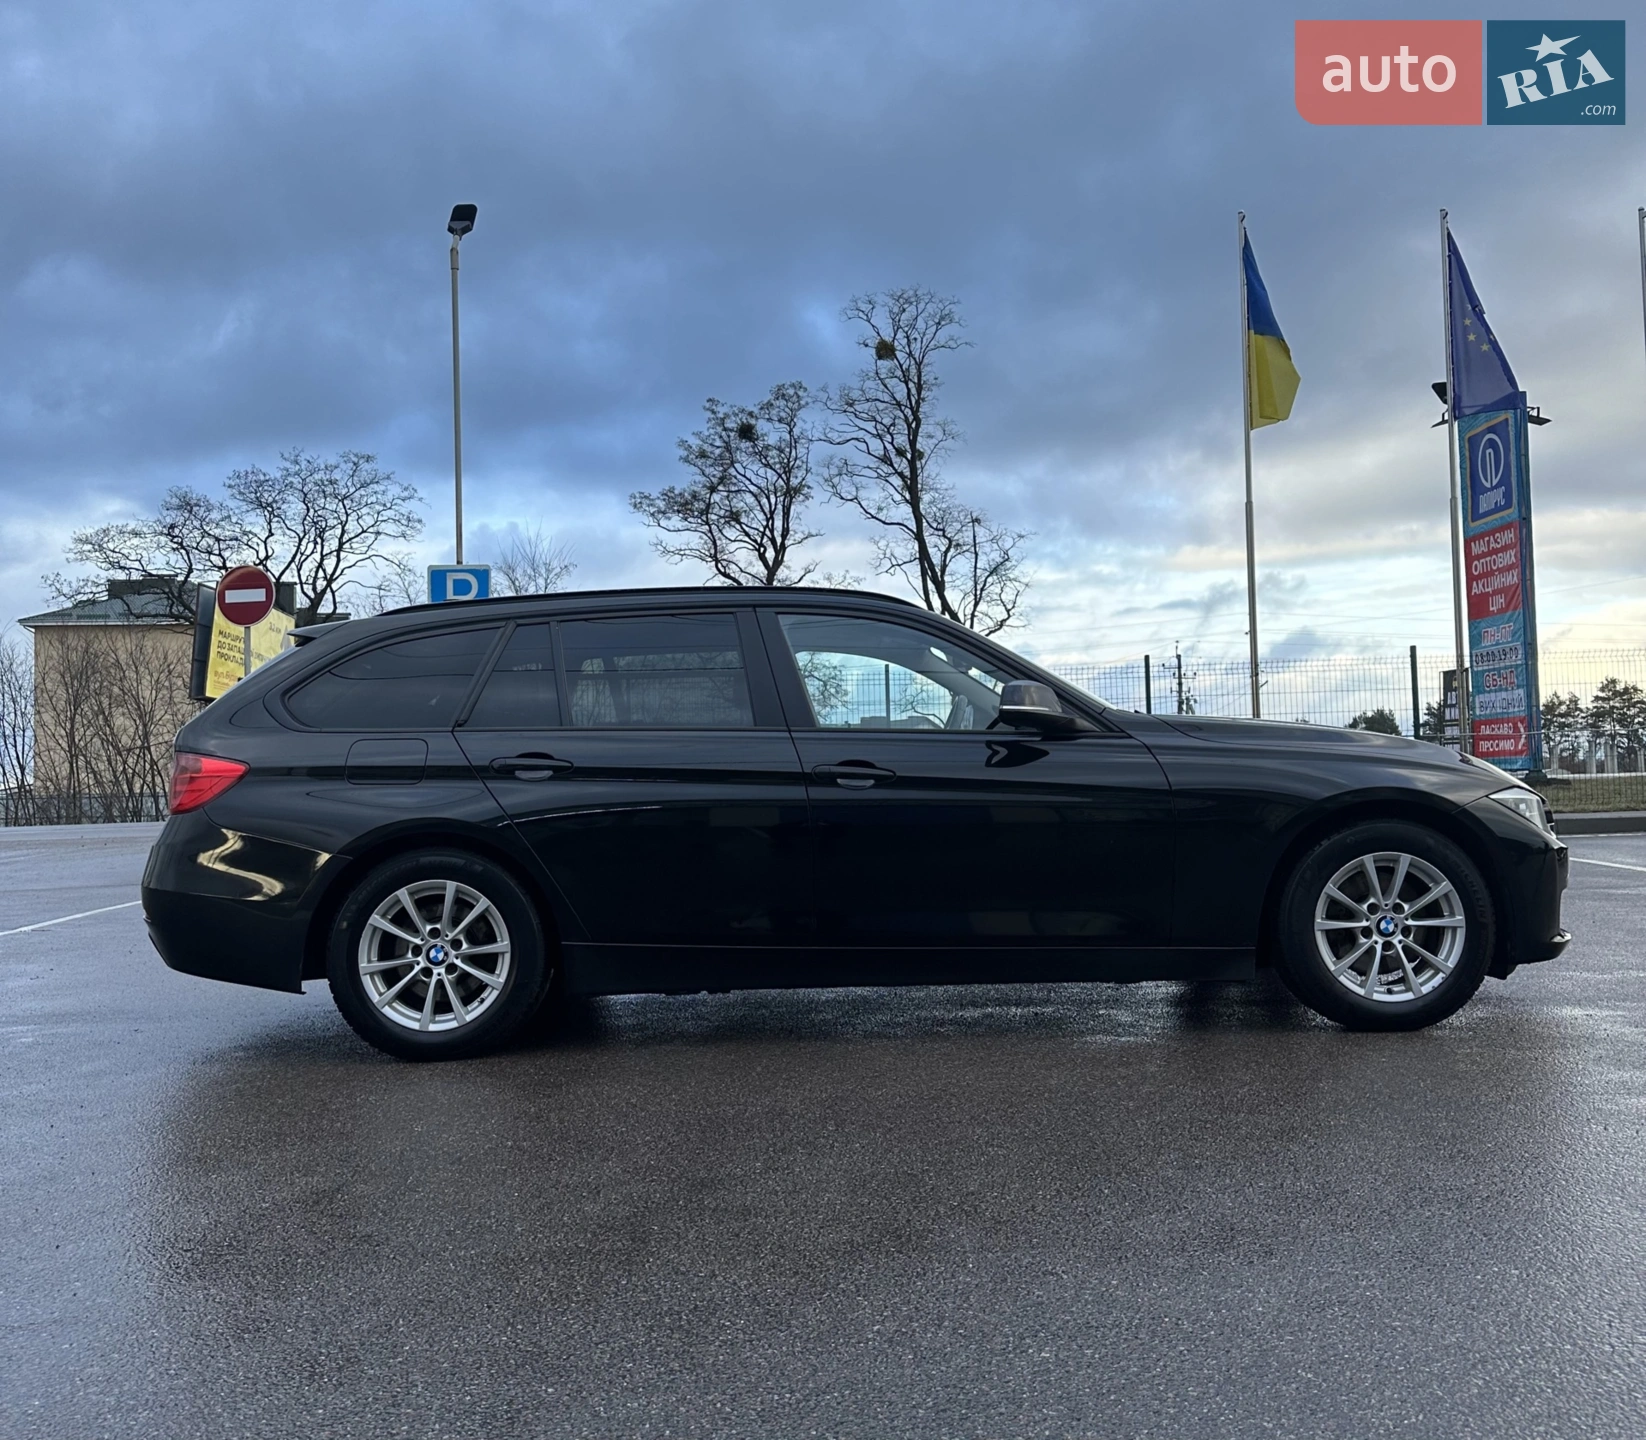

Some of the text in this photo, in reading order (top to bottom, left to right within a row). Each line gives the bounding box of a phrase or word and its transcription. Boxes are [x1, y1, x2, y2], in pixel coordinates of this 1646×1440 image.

[1471, 527, 1515, 556] МАГАЗИН
[1472, 548, 1516, 576] ОПТОВИХ
[1471, 568, 1519, 596] АКЦІЙНИХ
[1489, 593, 1505, 613] ЦІН
[1482, 623, 1513, 646] ПН-ПТ
[1484, 668, 1517, 691] СБ-НД
[1480, 722, 1513, 735] ЛАСКАВО
[1479, 739, 1515, 752] ПРОСИМО
